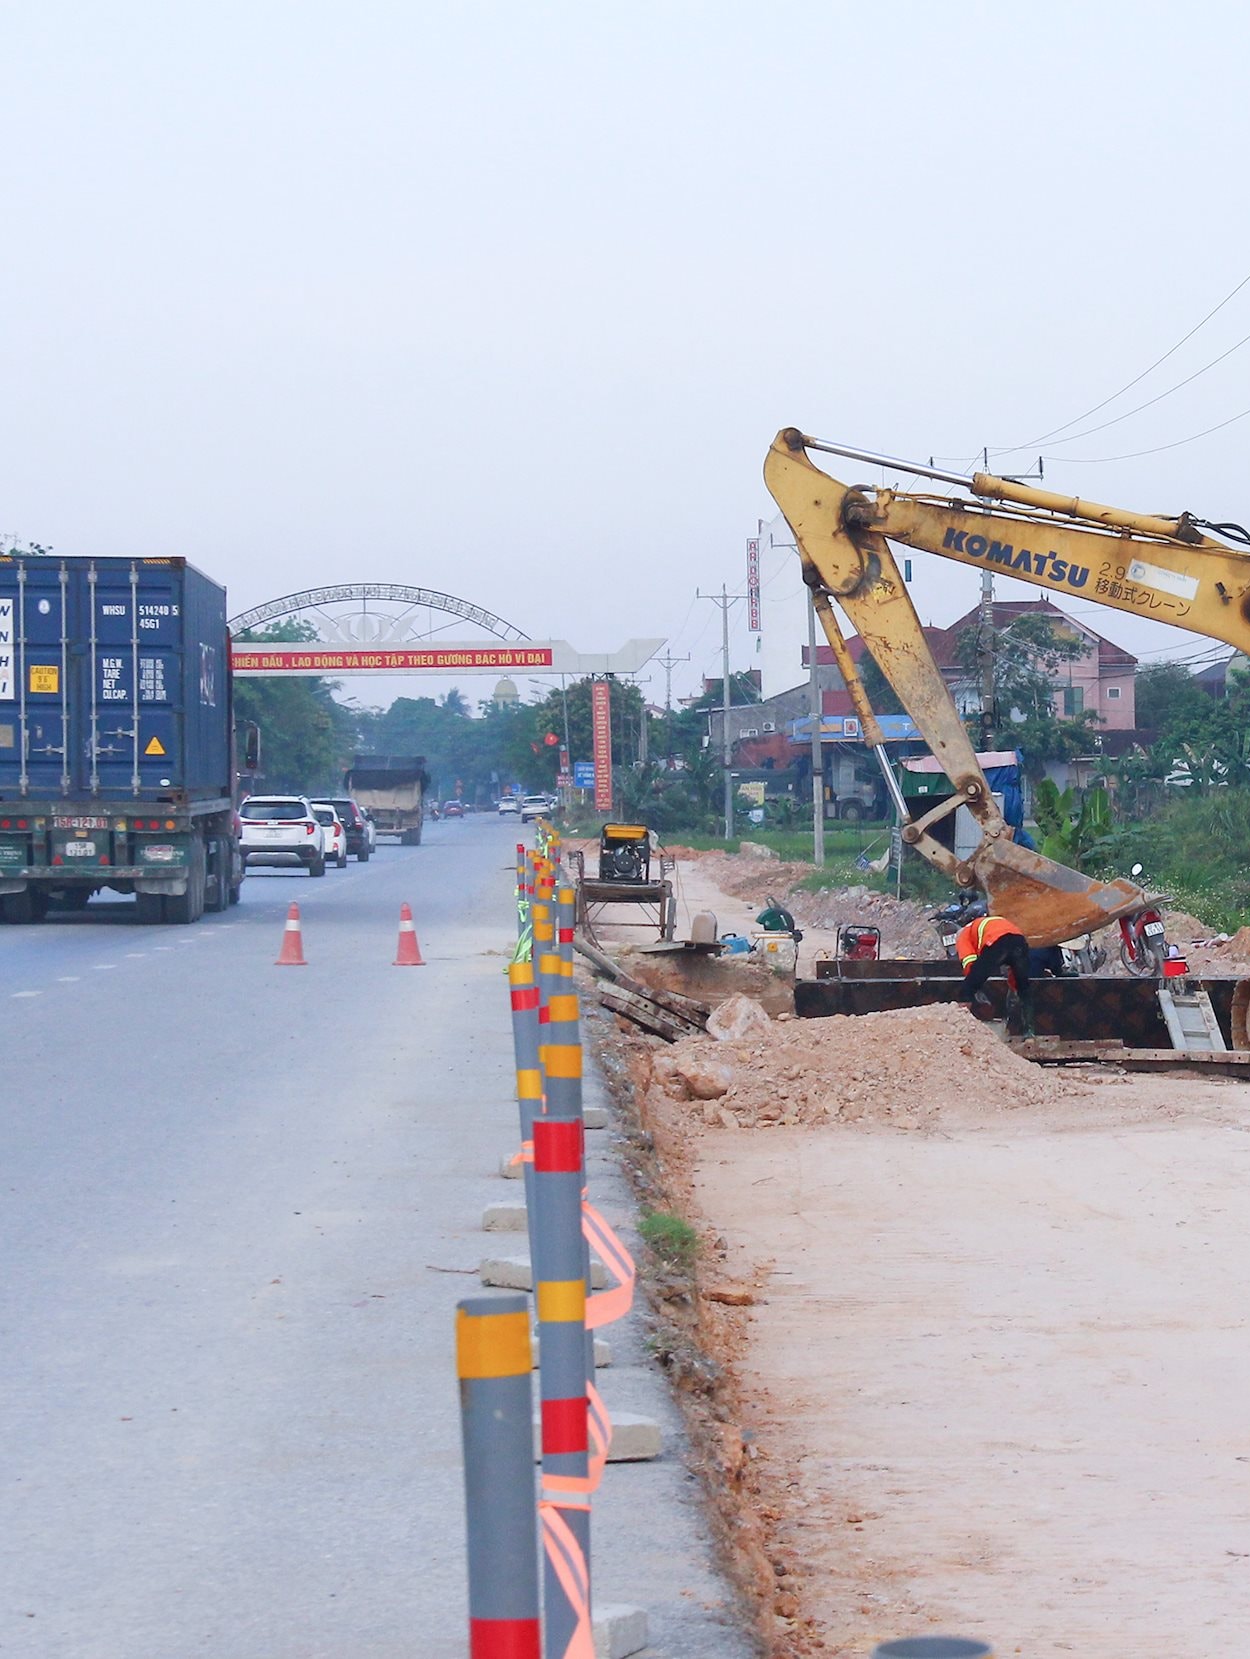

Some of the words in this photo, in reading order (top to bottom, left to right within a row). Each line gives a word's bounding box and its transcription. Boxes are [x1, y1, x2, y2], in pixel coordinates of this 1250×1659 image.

[942, 527, 1090, 588] KOMATSU
[1099, 561, 1129, 582] 2.9
[1095, 577, 1191, 617] 移動式クレーン
[102, 605, 126, 616] WHSU
[140, 619, 160, 629] 45G1
[292, 656, 311, 666] LAO
[314, 655, 343, 668] ĐỘNG
[346, 653, 359, 666] VÀ
[361, 655, 382, 669] HỌC
[385, 654, 404, 668] TẬP
[408, 655, 434, 666] THEO
[437, 653, 472, 666] GƯƠNG
[475, 651, 496, 665] BÁC
[528, 652, 545, 665] ĐẠI
[103, 669, 121, 679] TARE
[103, 680, 116, 689] NET
